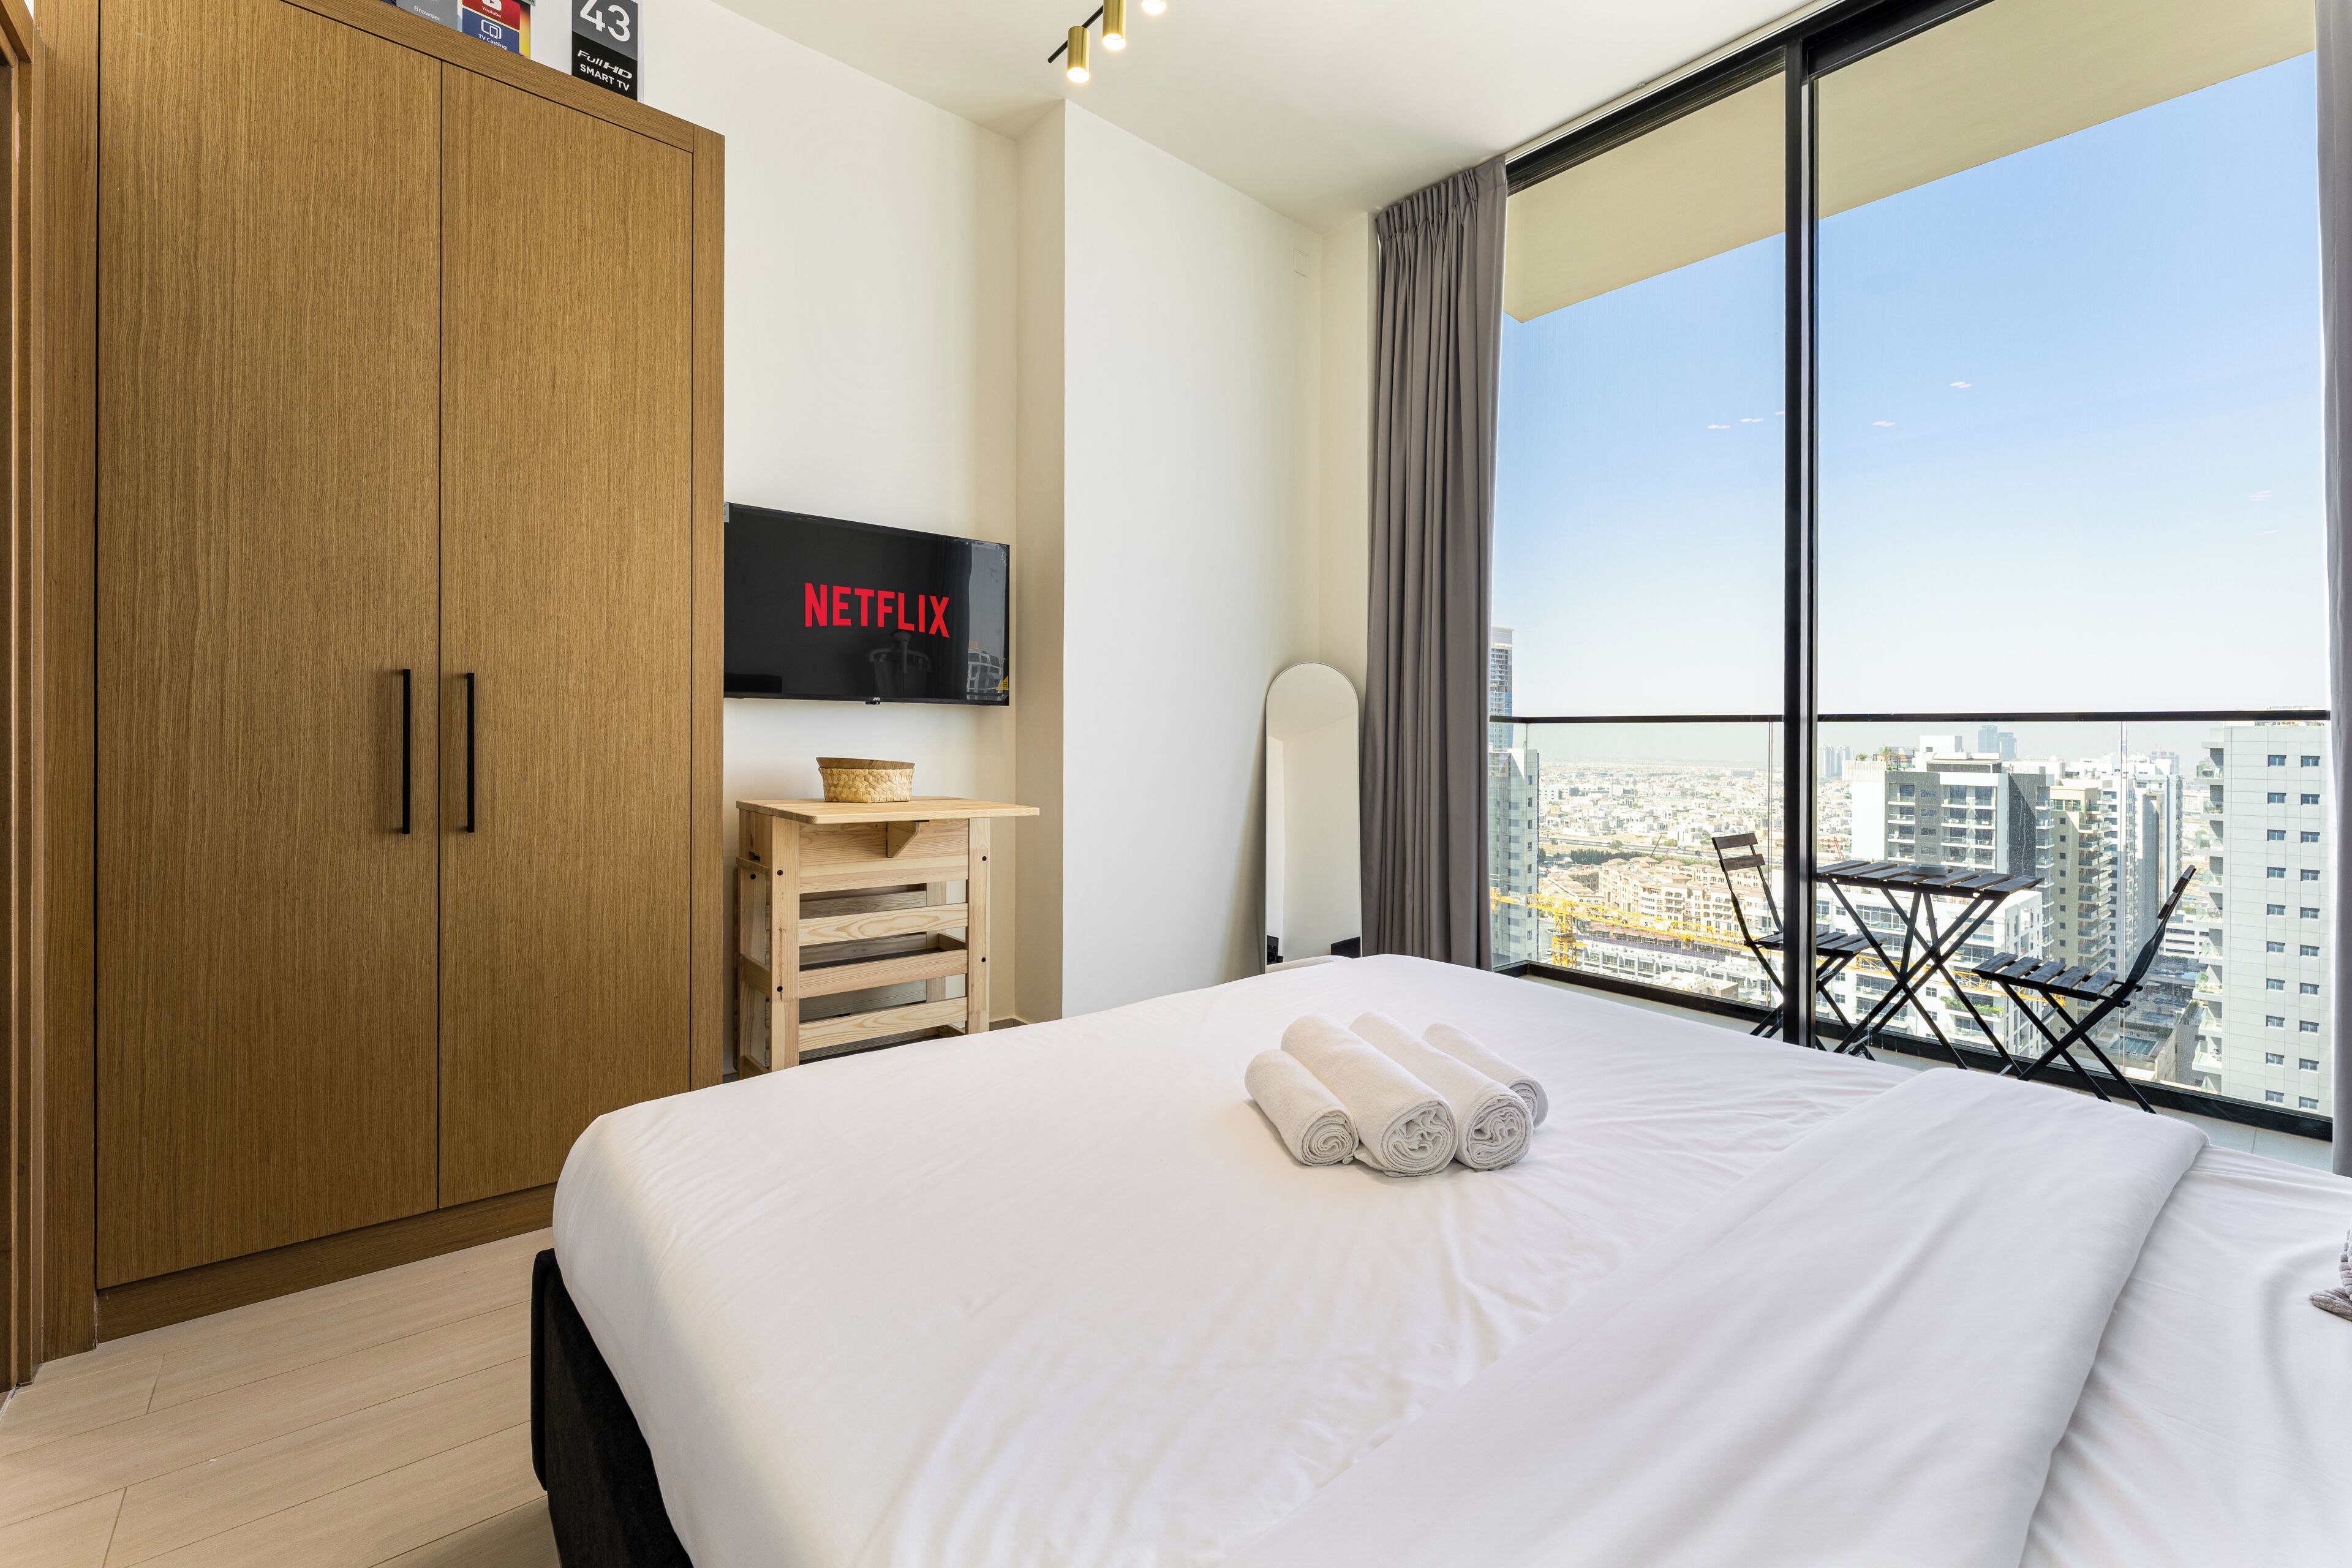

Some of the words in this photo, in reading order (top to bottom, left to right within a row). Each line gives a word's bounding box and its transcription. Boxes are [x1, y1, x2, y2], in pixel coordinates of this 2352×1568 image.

[413, 6, 441, 21] Browser
[481, 6, 502, 18] Youtube
[580, 0, 630, 42] 43
[486, 37, 507, 50] Casting
[579, 64, 615, 85] SMART
[616, 79, 630, 91] TV
[805, 582, 950, 638] NETFLIX
